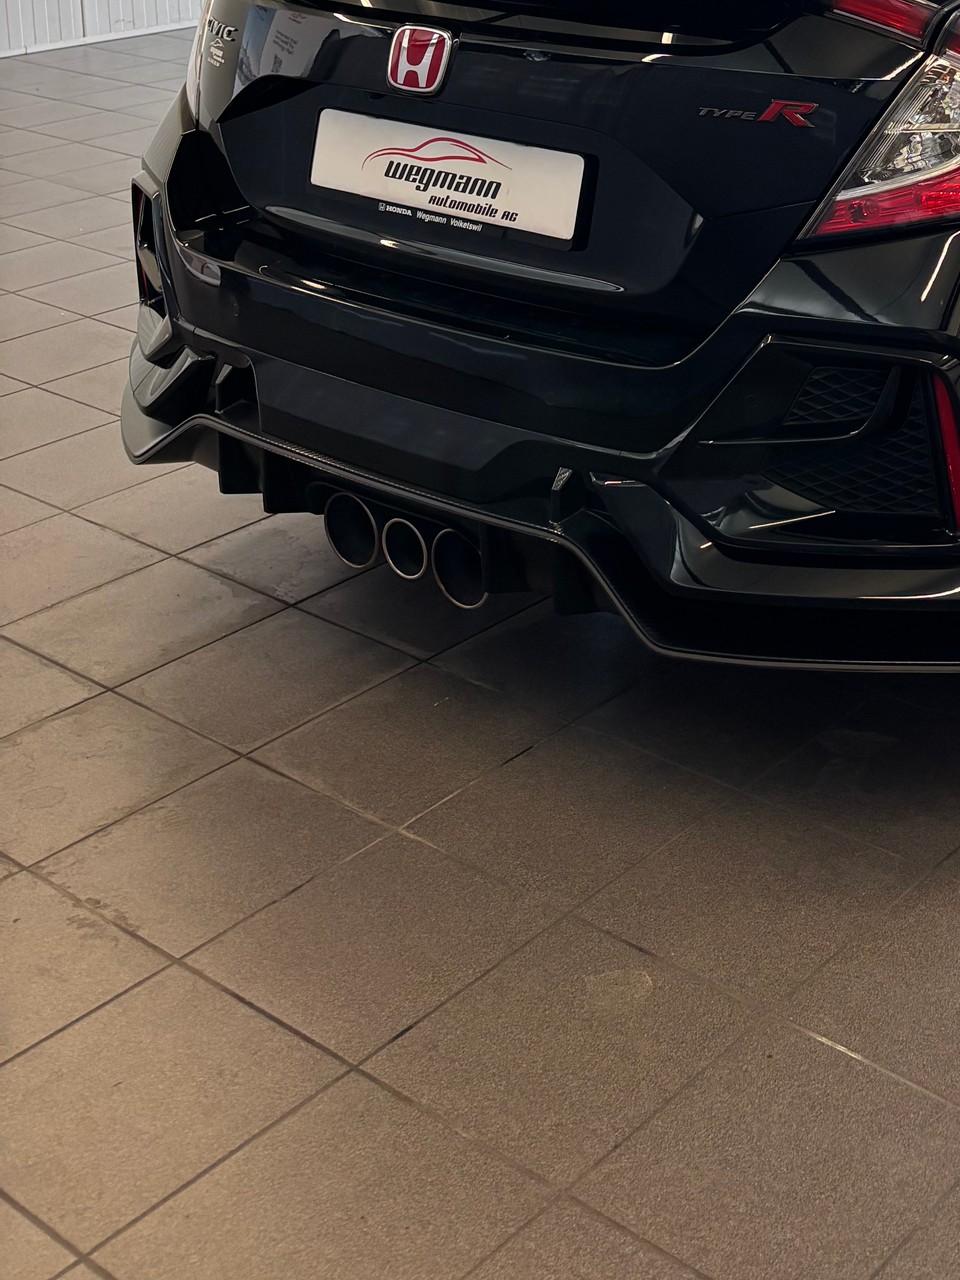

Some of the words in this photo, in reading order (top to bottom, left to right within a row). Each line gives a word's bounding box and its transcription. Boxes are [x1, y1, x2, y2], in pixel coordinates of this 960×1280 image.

[699, 107, 757, 120] TYPE
[757, 99, 819, 128] R
[384, 160, 502, 199] wegmann
[385, 205, 413, 217] HONDA
[416, 210, 447, 225] Wegmann
[450, 217, 483, 233] Volketswil
[428, 195, 498, 218] automobile
[501, 211, 518, 222] AG
